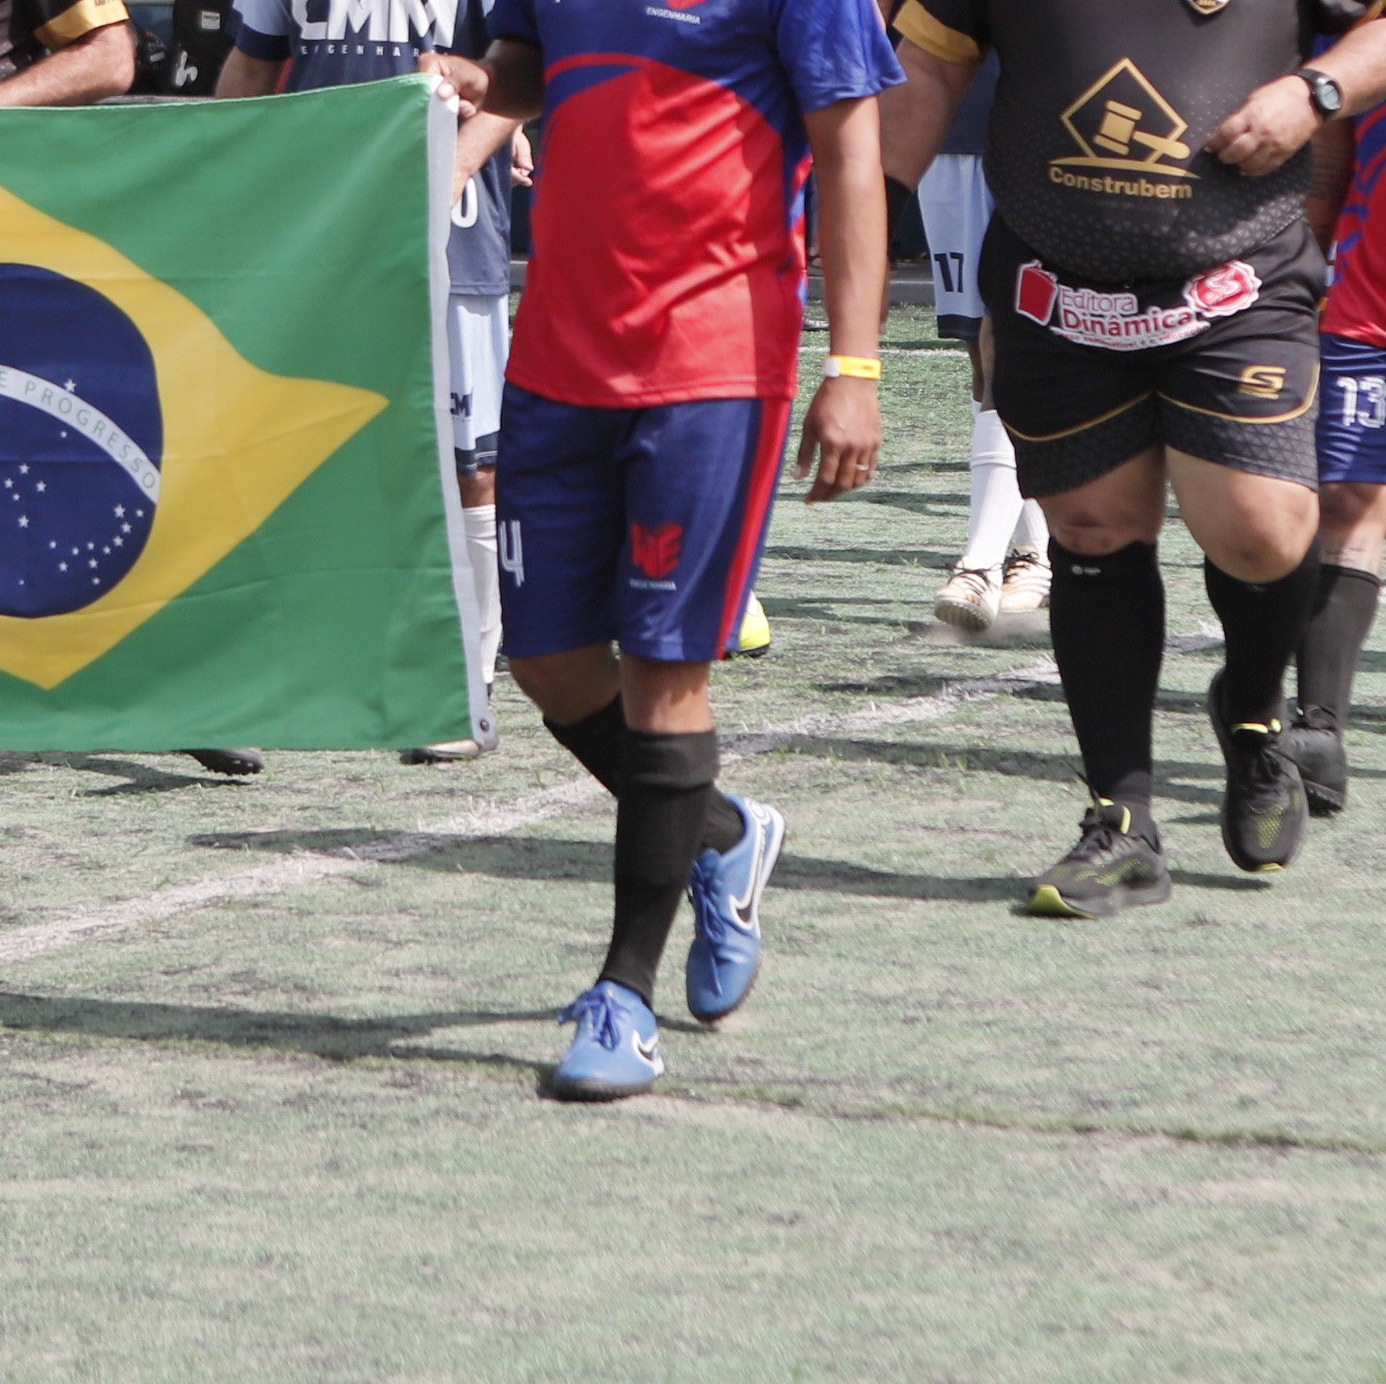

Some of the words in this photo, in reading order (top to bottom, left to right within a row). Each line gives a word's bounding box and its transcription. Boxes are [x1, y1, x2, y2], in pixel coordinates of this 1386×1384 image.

[645, 5, 702, 25] ENGENHARIA
[1049, 166, 1193, 199] Construbem
[933, 251, 965, 294] 17
[1063, 290, 1134, 312] Editora
[1064, 309, 1193, 336] Dinâmica
[24, 380, 158, 490] PROGRESSO
[499, 520, 526, 588] 4
